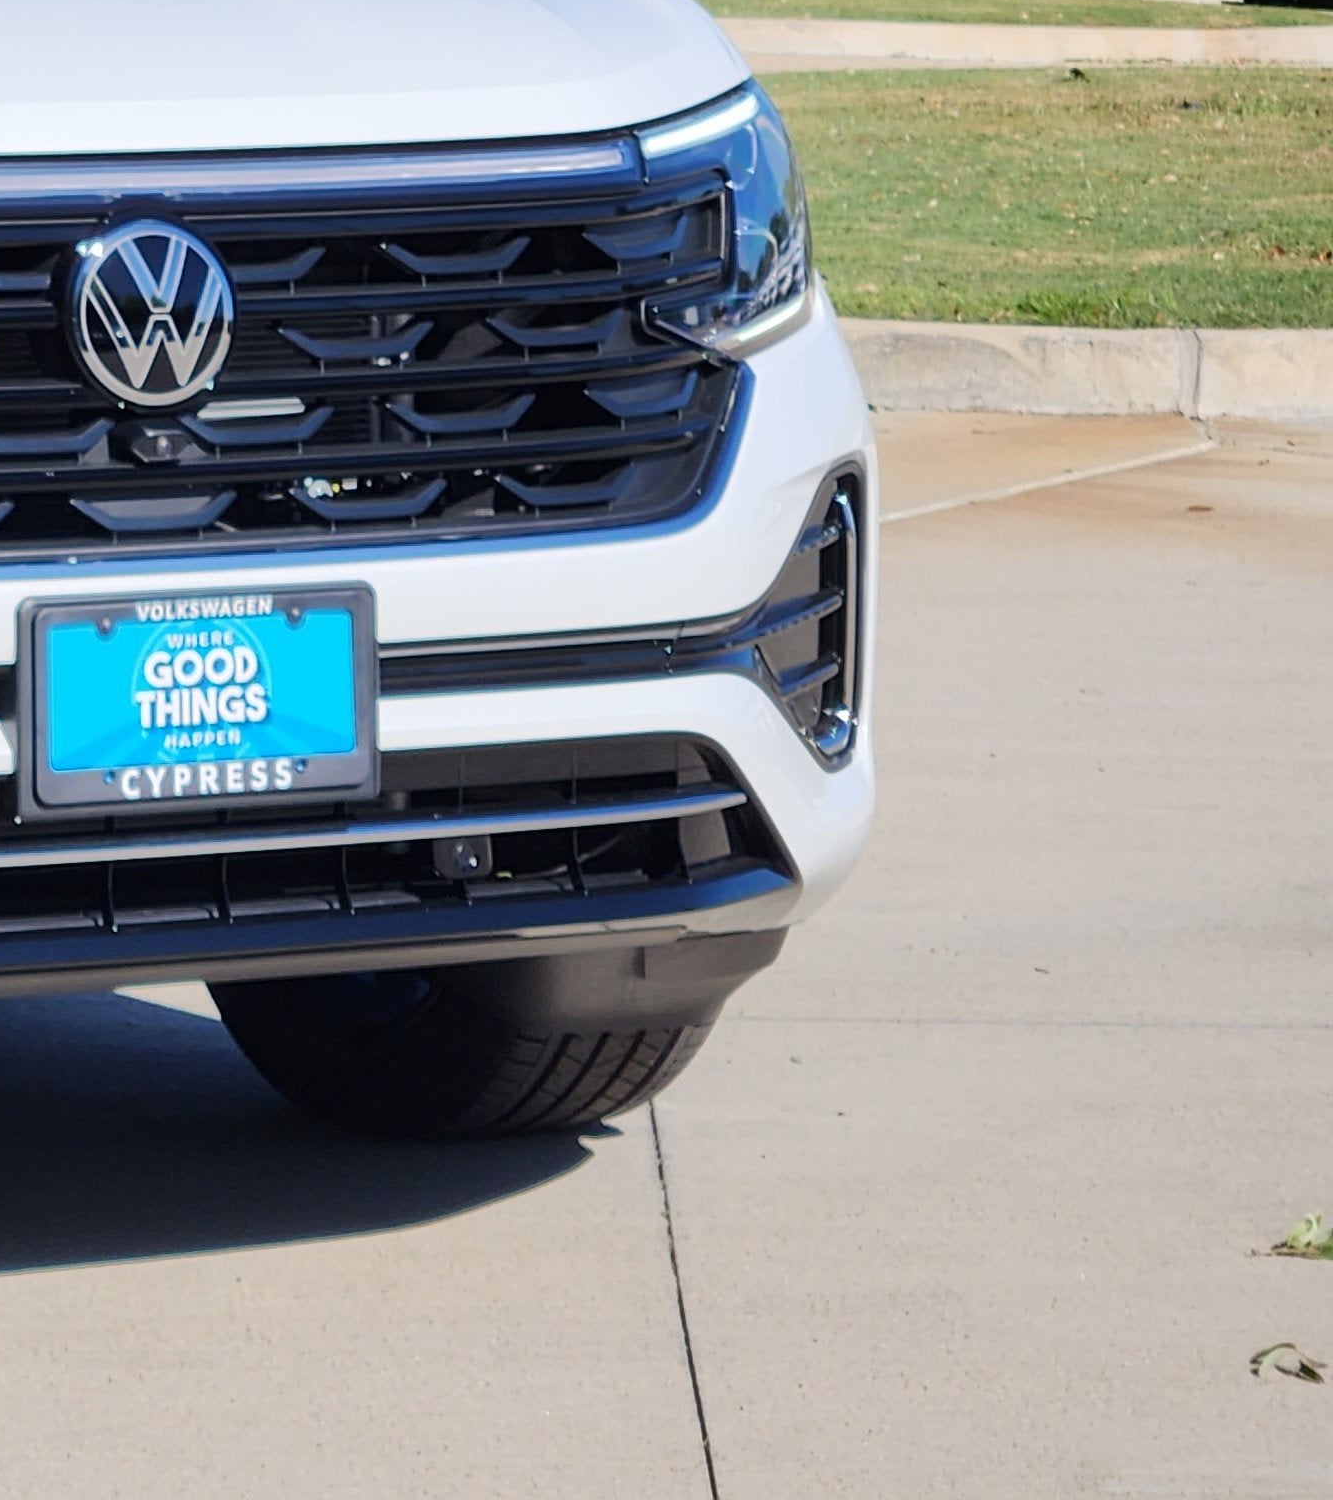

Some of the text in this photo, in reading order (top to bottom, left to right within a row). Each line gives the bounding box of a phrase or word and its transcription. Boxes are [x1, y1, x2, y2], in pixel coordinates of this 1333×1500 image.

[136, 595, 272, 621] VOLKSWAGEN
[167, 631, 234, 649] WHERE
[145, 646, 258, 688] GOOD
[136, 684, 267, 728] THINGS
[165, 728, 241, 748] HAPPEN
[121, 758, 293, 800] CYPRESS
